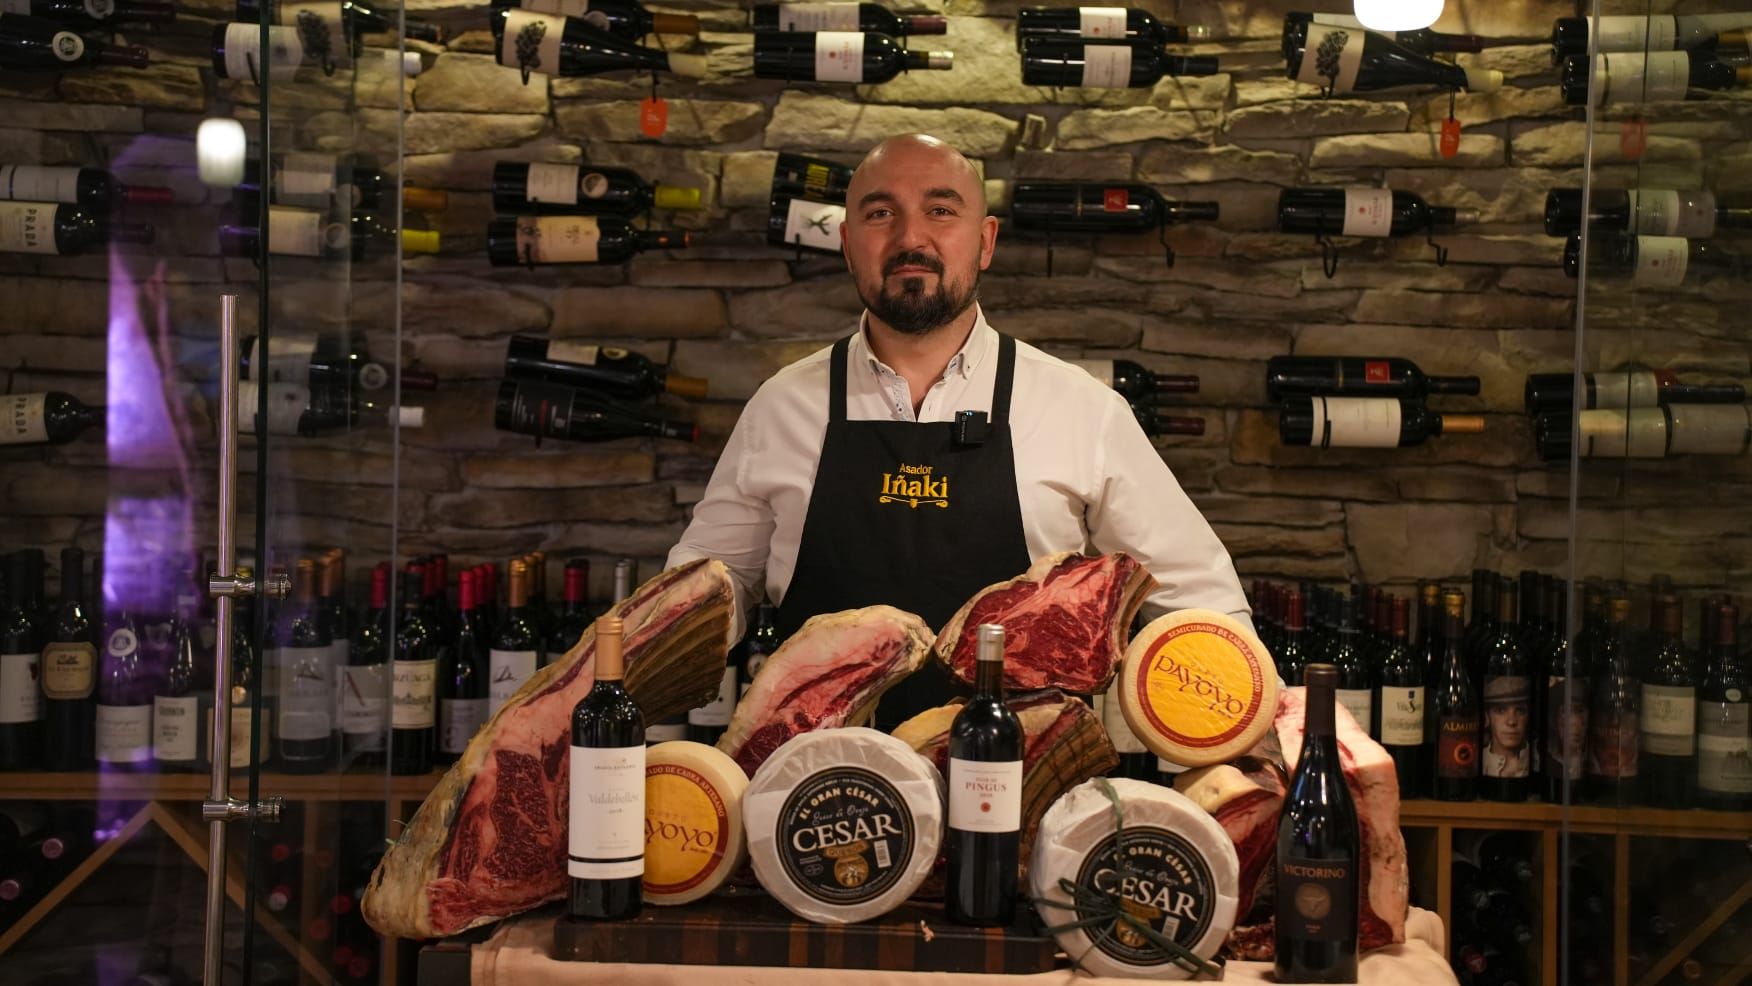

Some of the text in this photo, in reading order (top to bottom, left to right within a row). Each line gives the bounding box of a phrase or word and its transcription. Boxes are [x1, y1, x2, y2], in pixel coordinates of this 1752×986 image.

[25, 208, 37, 247] PRADA
[15, 397, 27, 435] PRADA
[899, 463, 934, 475] Asador
[880, 473, 949, 498] Iñaki
[1168, 624, 1217, 638] SEMICURADO
[1216, 627, 1229, 638] DE
[965, 782, 1007, 793] PINGUS
[800, 808, 811, 820] EL
[810, 787, 842, 807] GRAN
[792, 814, 903, 852] CESAR
[1128, 846, 1163, 857] GRAN
[1283, 864, 1346, 878] VICTORINO
